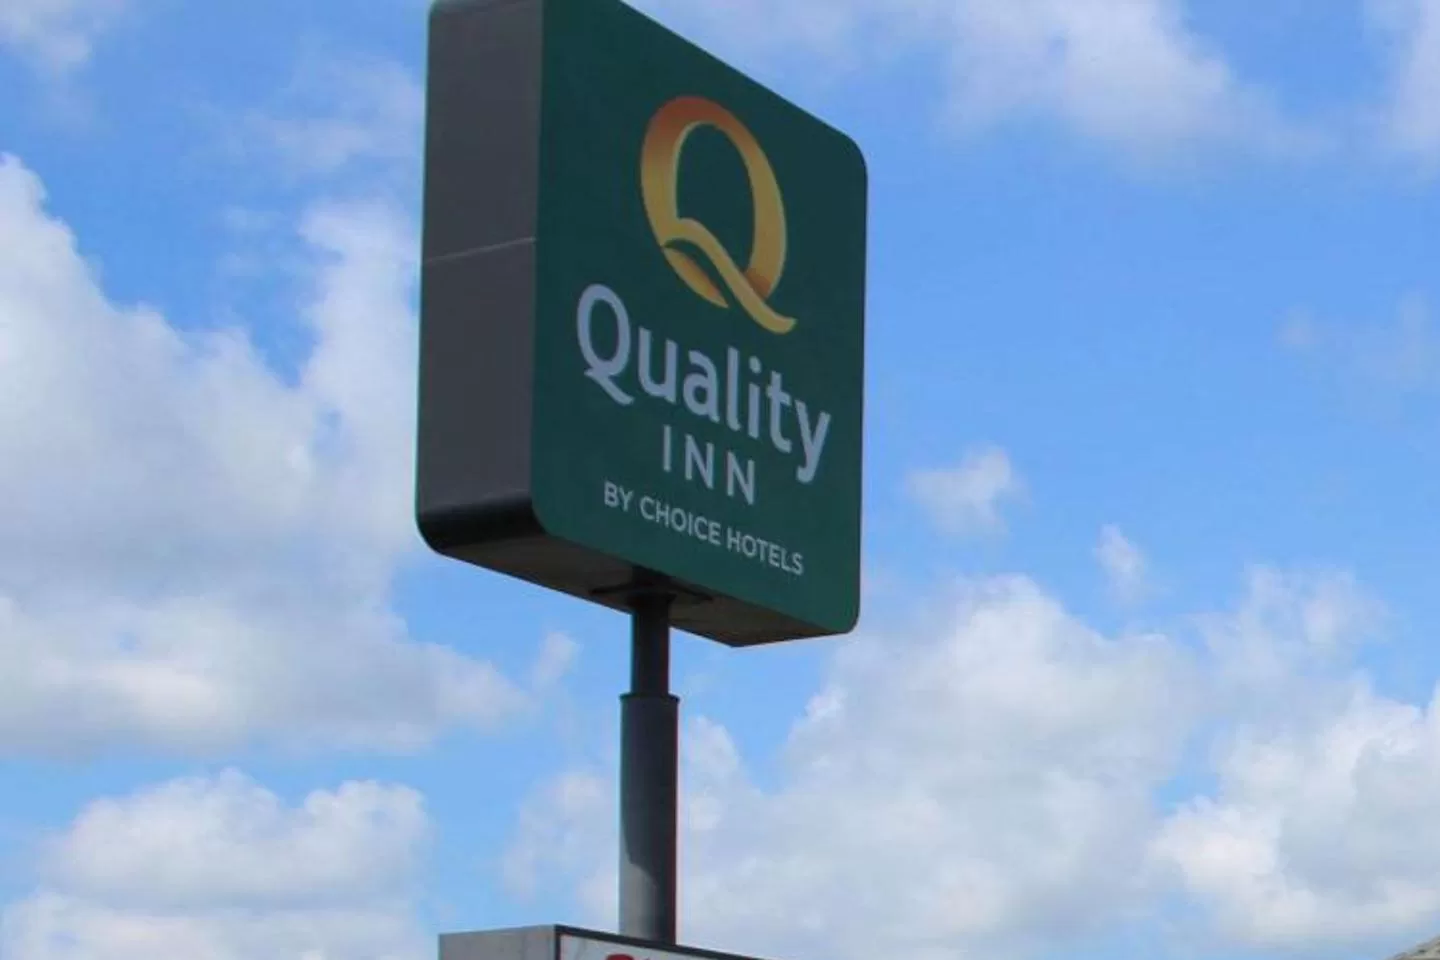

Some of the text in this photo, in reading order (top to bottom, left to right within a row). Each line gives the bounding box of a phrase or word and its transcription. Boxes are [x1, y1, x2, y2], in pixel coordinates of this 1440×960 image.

[640, 95, 796, 334] Q
[576, 283, 831, 483] Quality
[604, 481, 804, 576] BY CHOICE HOTELS
[662, 424, 756, 505] INN
